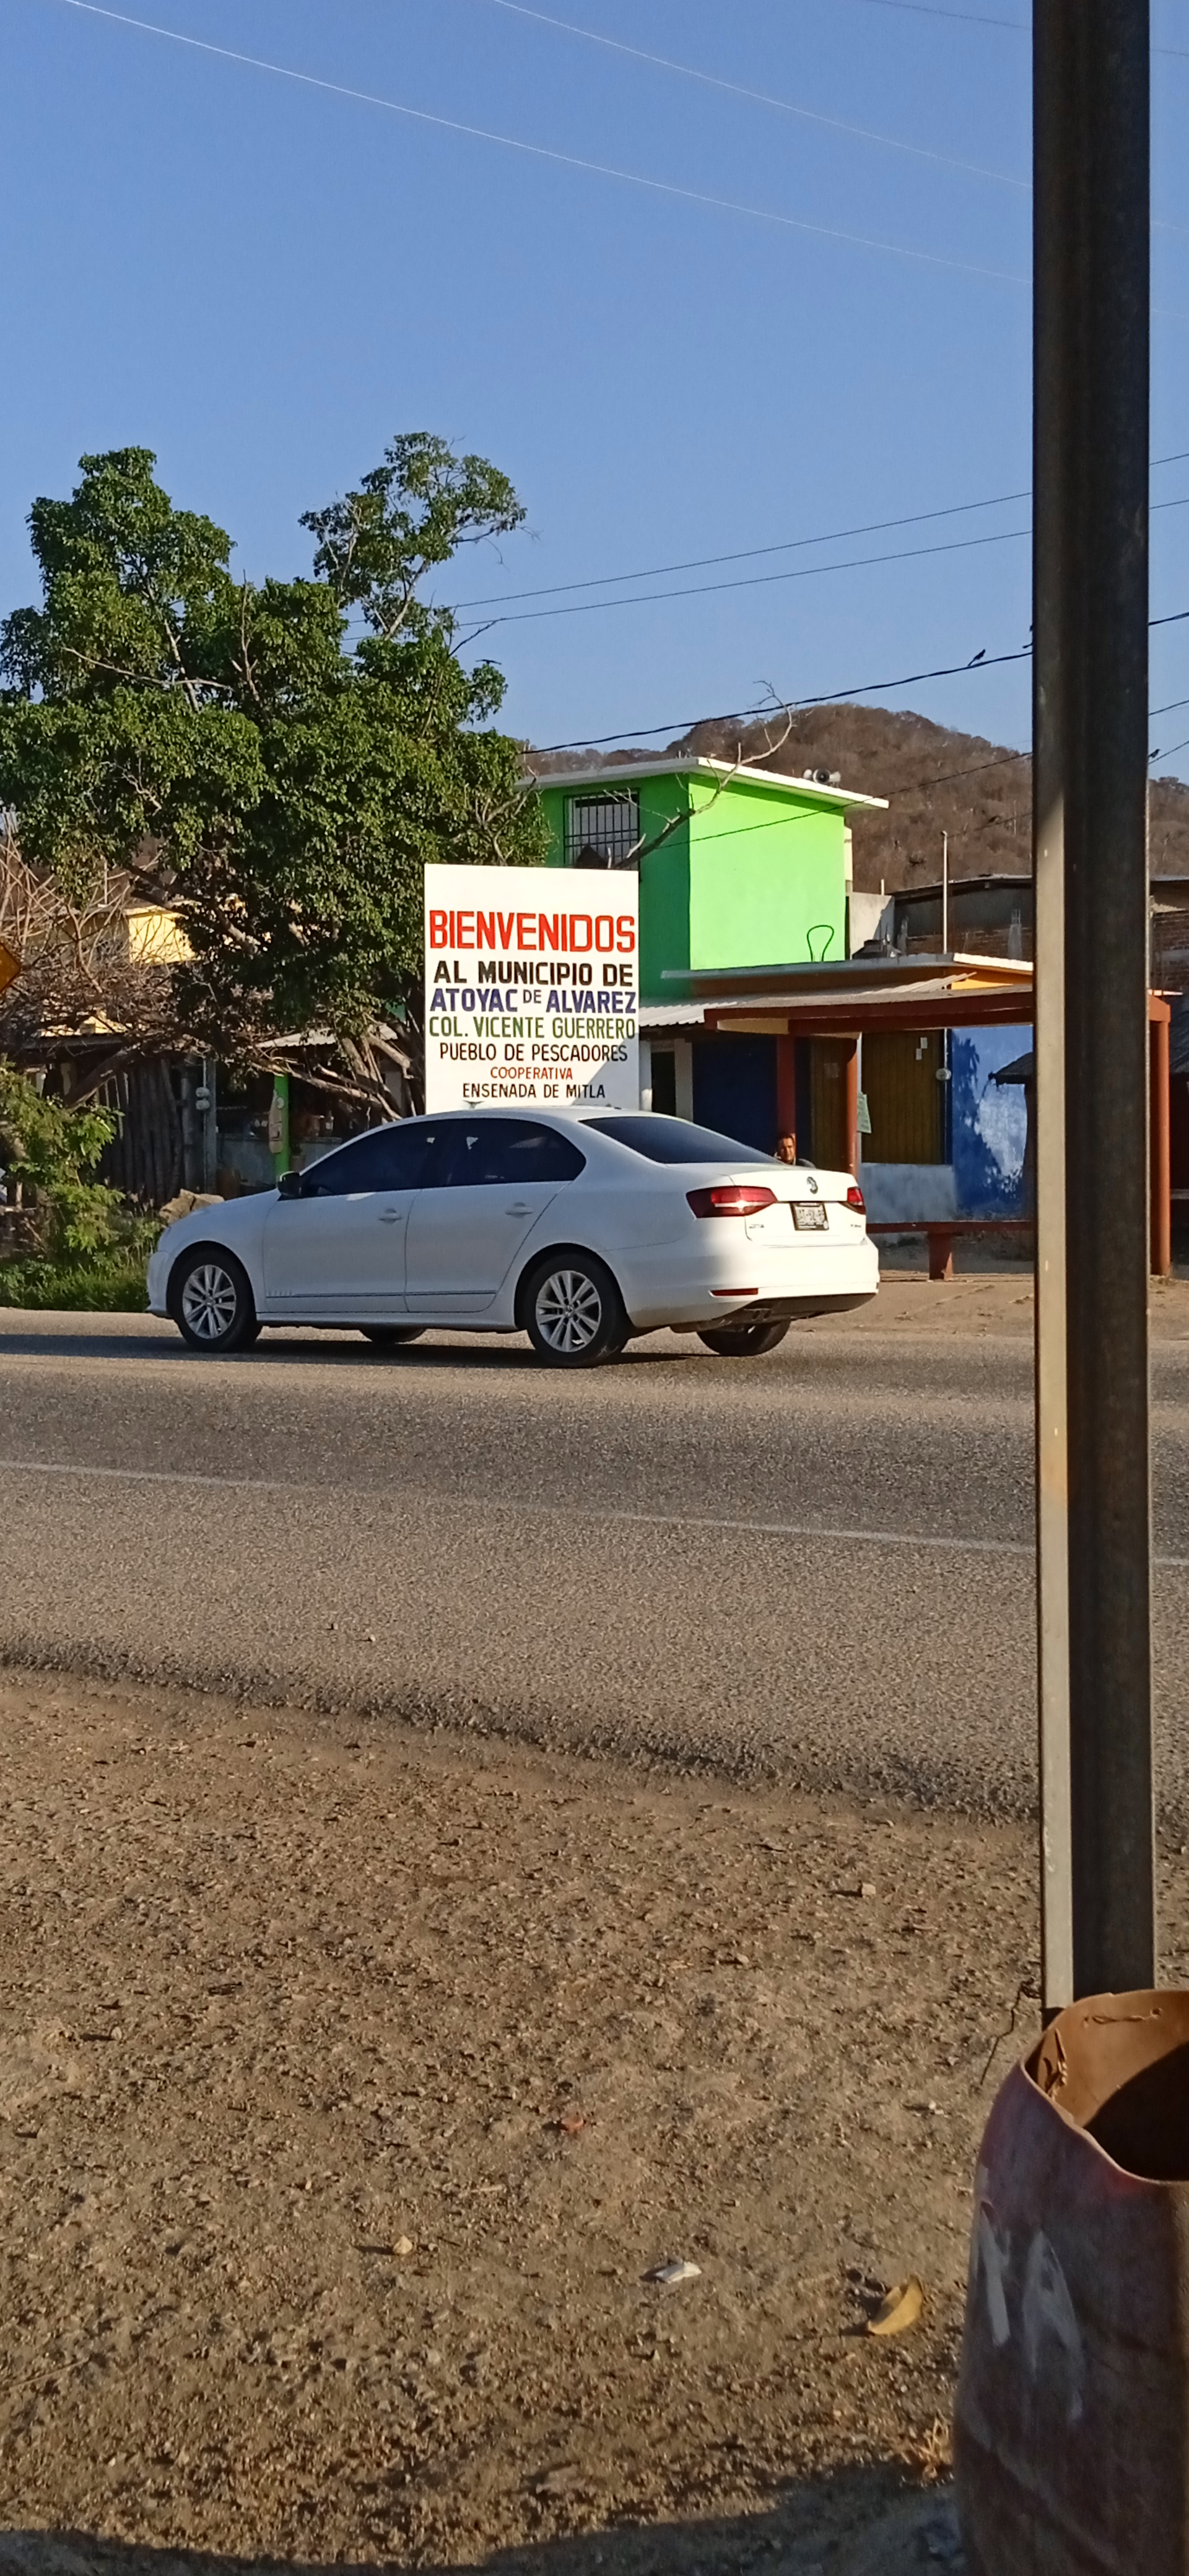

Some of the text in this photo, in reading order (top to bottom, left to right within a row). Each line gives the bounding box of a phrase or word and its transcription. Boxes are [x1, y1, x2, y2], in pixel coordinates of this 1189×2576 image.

[429, 910, 635, 953] BIENVENIDOS
[433, 960, 633, 987] AL MUNICIPIO DE
[430, 988, 636, 1014] ATOYAC DE ALVAREZ
[429, 1016, 635, 1040] COL. VICENTE GUERRERO
[440, 1042, 628, 1063] PUEBLO DE PESCADORES
[490, 1066, 573, 1080] COOPERATIVA
[463, 1083, 606, 1099] ENSENADA DE MITLA
